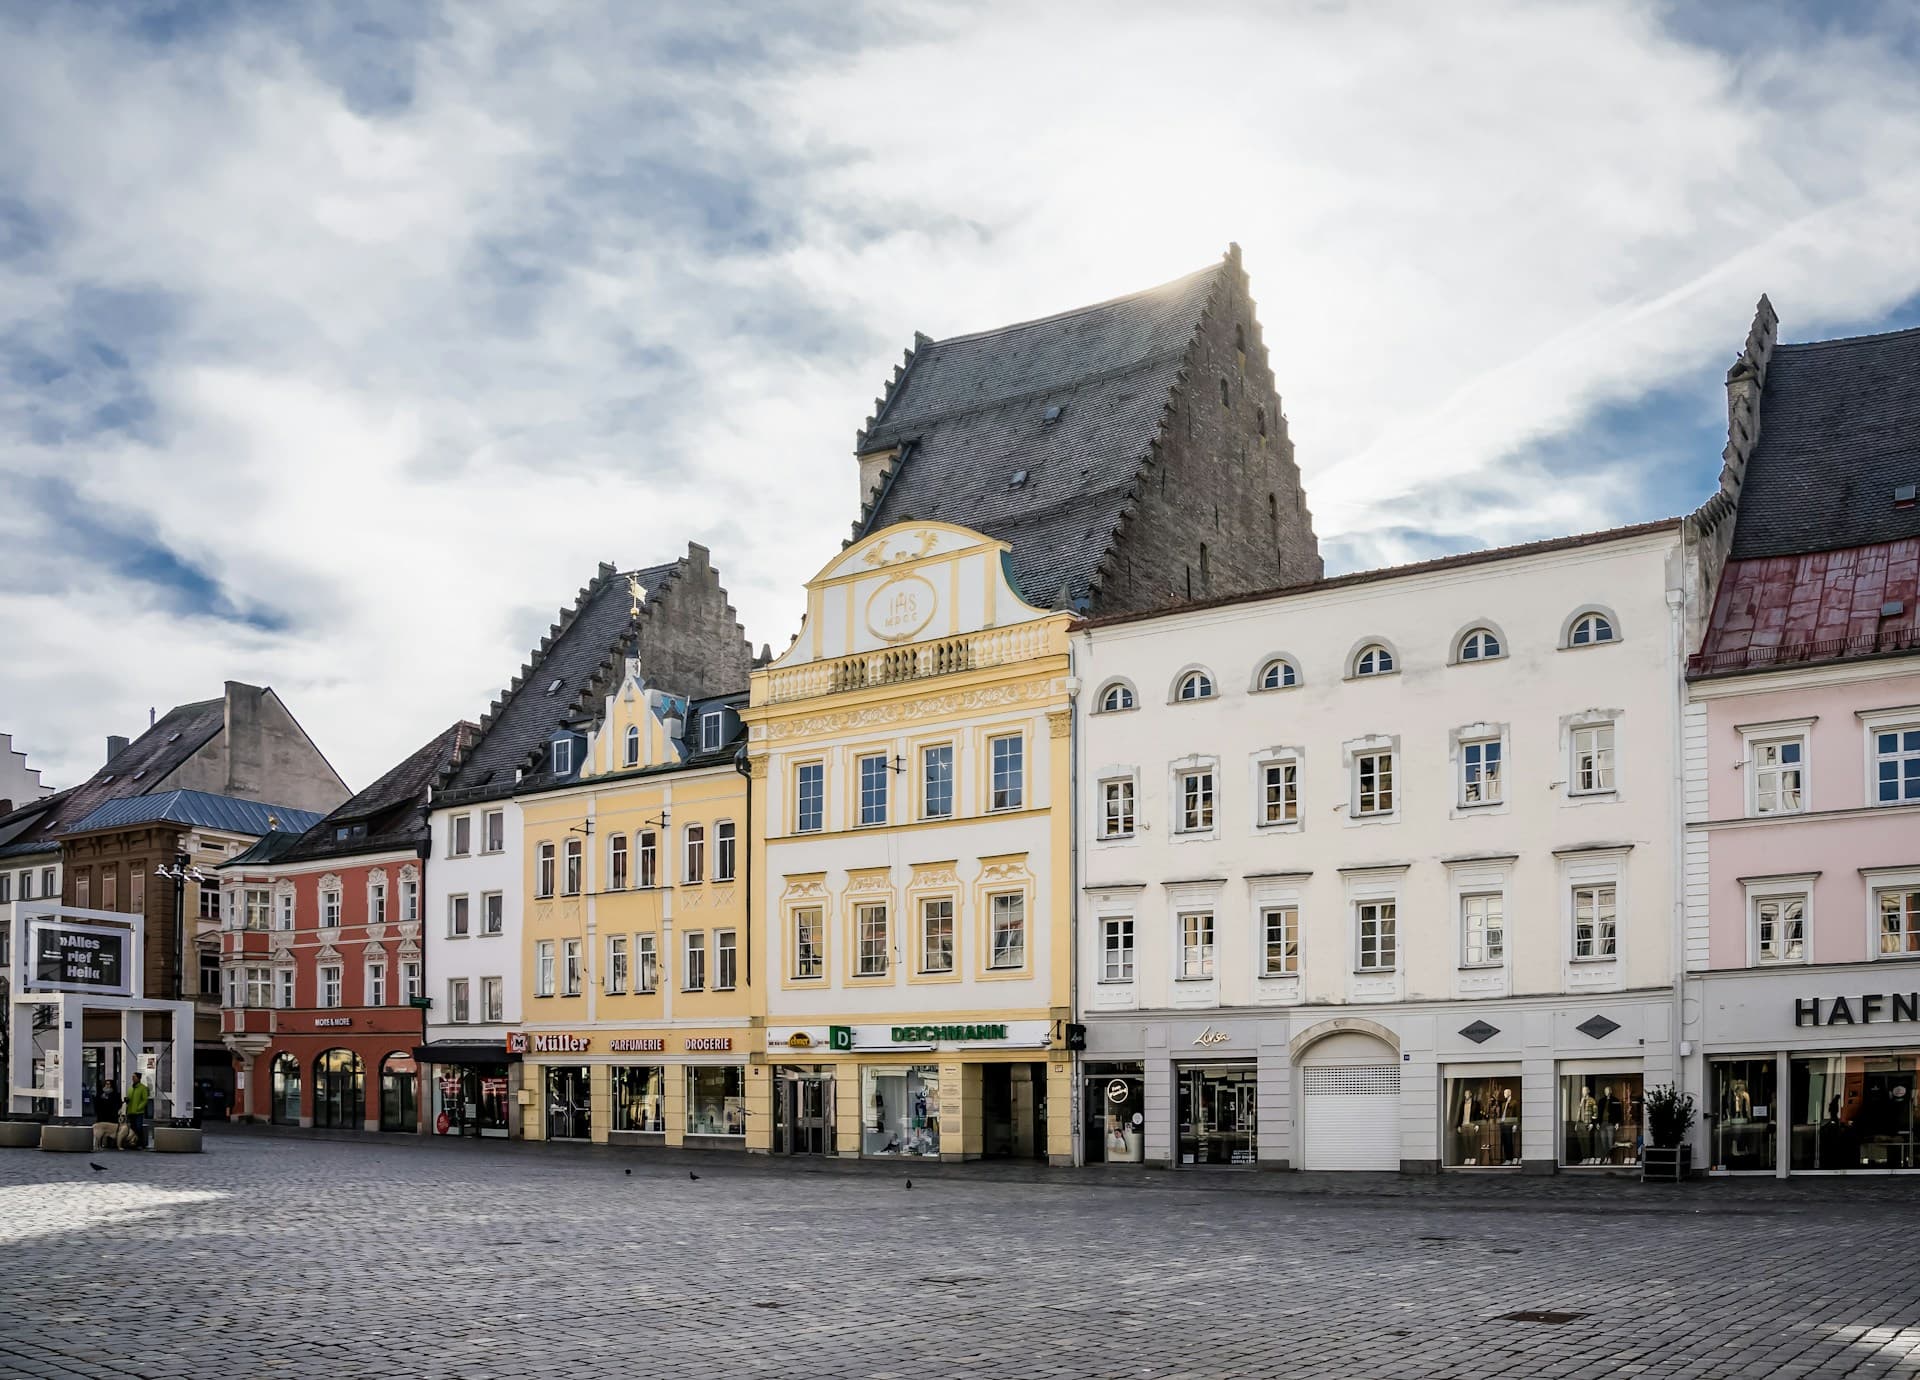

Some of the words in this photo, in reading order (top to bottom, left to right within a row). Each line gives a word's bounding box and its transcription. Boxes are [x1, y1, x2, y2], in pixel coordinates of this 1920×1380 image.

[67, 951, 92, 963] rief
[1795, 992, 1918, 1026] HAFN
[315, 1018, 330, 1026] MORE
[335, 1018, 350, 1026] MORE
[837, 1031, 849, 1046] D
[891, 1024, 1006, 1041] DEICHMANN
[535, 1035, 590, 1052] Müller
[610, 1039, 663, 1051] PARFUMERIE
[685, 1038, 730, 1050] DROGERIE
